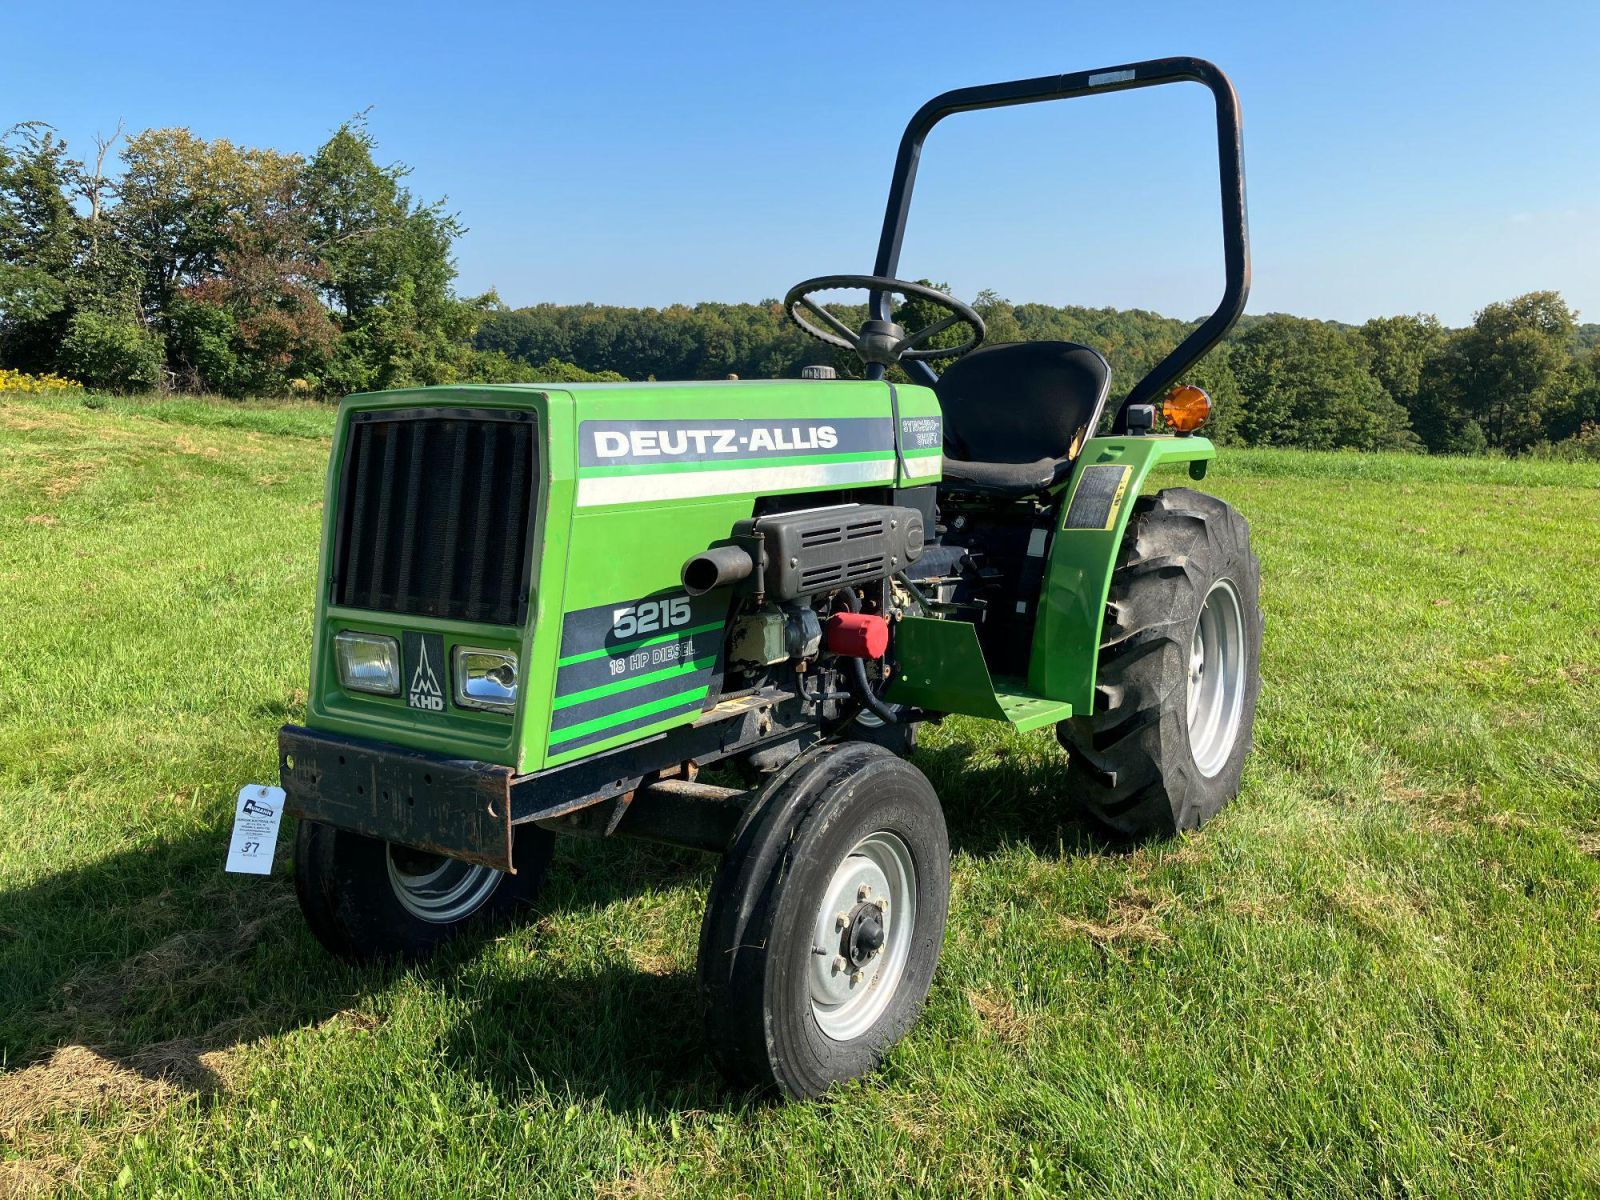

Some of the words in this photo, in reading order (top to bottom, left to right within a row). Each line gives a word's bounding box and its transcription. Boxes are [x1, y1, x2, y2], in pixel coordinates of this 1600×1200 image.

[593, 425, 838, 458] DEUTZ-ALLIS
[613, 596, 691, 639] 5215
[609, 658, 626, 675] 18
[630, 651, 650, 671] HP
[652, 640, 696, 665] DIESEL
[409, 693, 443, 711] KHD
[241, 841, 260, 854] 37
